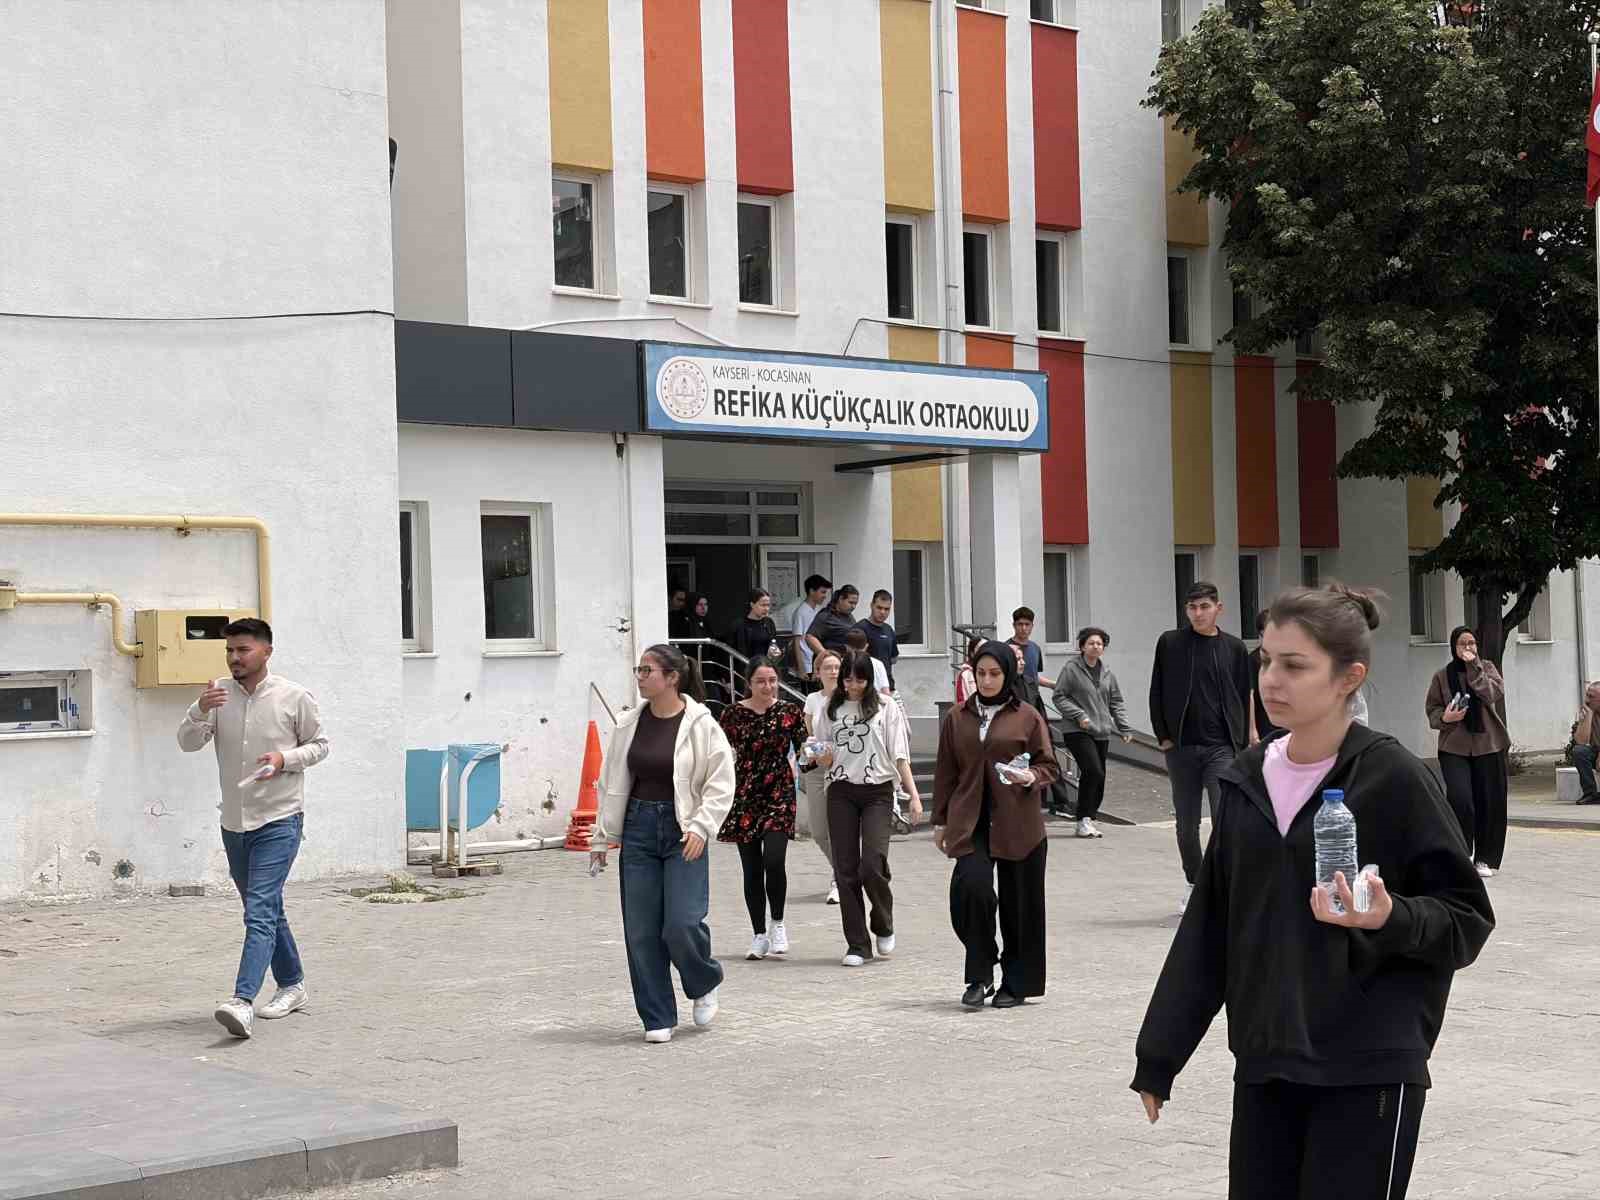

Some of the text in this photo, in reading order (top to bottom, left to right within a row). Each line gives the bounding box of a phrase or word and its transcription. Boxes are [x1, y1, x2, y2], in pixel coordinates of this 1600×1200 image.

[713, 365, 750, 380] KAYSERİ
[757, 368, 811, 384] KOCASİNAN
[714, 384, 786, 418] REFİKA
[792, 388, 915, 431] KÜÇÜKÇALIK
[919, 401, 1029, 433] ORTAOKULU
